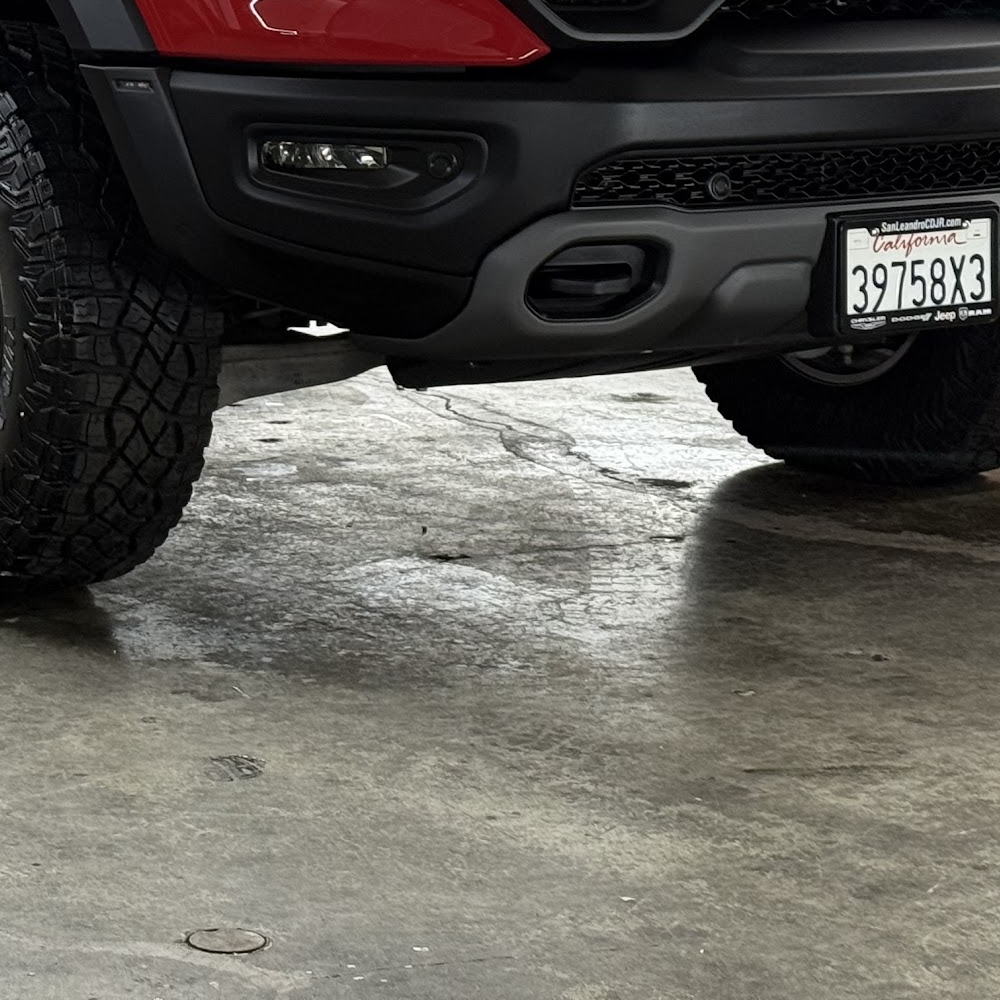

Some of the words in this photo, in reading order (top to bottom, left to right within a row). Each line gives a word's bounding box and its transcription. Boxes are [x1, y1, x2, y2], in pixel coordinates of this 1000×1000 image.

[881, 217, 962, 233] SanLeandroCDJR.com
[872, 232, 967, 258] California
[851, 253, 986, 314] 39758X3
[934, 310, 956, 323] Jeep
[968, 308, 993, 317] RAM
